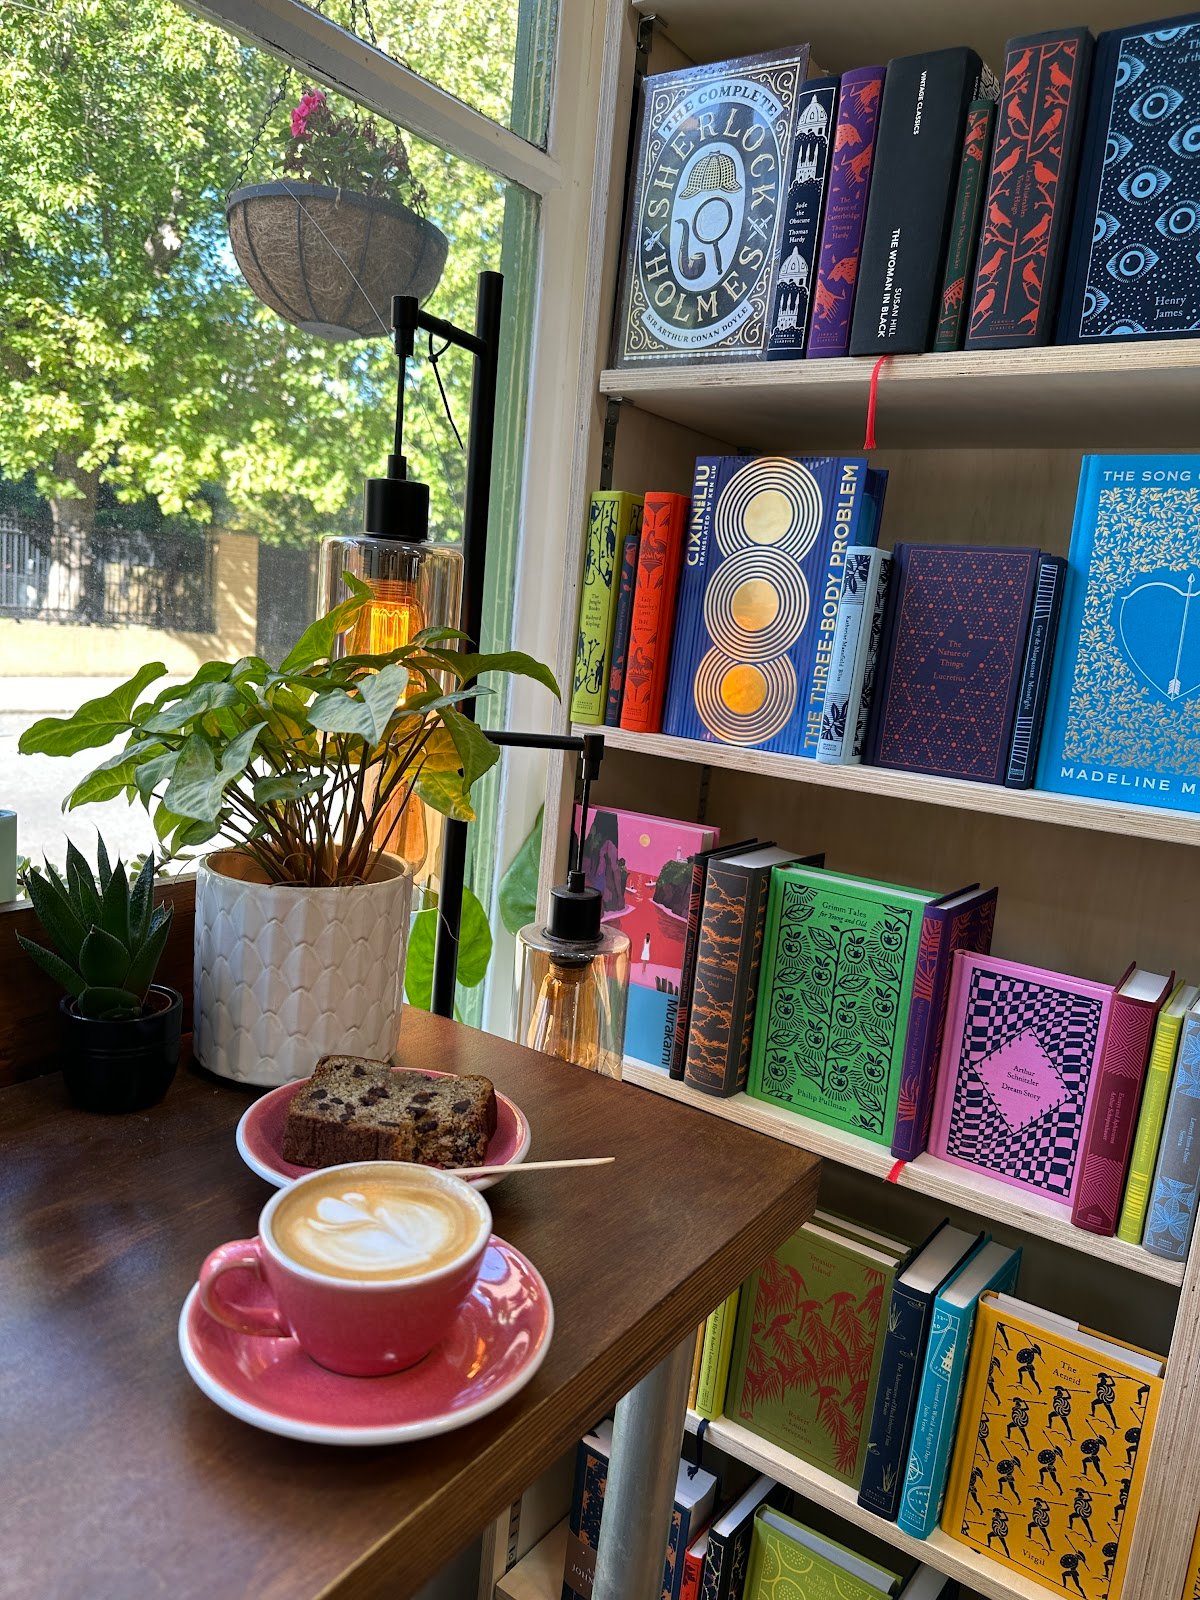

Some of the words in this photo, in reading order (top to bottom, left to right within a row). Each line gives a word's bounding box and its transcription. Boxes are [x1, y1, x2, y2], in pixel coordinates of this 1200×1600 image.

[1178, 53, 1190, 64] of
[917, 70, 927, 101] VINTAGE
[663, 102, 694, 133] THE
[698, 85, 778, 117] COMPLETE
[913, 101, 923, 135] CLASSICS
[648, 107, 775, 218] SHERLOCK
[795, 202, 808, 210] Jude
[890, 228, 900, 248] THE
[884, 250, 897, 291] WOMAN
[645, 246, 763, 322] HOLMES
[882, 293, 891, 304] IN
[891, 287, 902, 317] SUSAN
[1155, 296, 1186, 307] Henry
[646, 315, 657, 328] SIR
[657, 325, 689, 342] ARTHUR
[690, 329, 720, 342] CONAN
[722, 306, 748, 332] DOYLE
[877, 306, 889, 338] BLACK
[1154, 309, 1183, 320] James
[888, 319, 898, 338] HILL
[693, 465, 710, 500] LIU
[1103, 471, 1135, 482] THE
[1141, 470, 1191, 482] SONG
[829, 465, 859, 567] PROBLEM
[687, 507, 705, 566] CIXIN
[699, 515, 710, 567] TRANSLATED
[706, 501, 712, 512] BY
[810, 573, 842, 705] THREE-BODY
[1035, 624, 1044, 639] Guy
[803, 711, 823, 749] THE
[1060, 766, 1171, 791] MADELINE
[822, 901, 846, 913] Grimm
[848, 907, 867, 918] Tales
[661, 998, 678, 1066] Murakami
[1006, 1071, 1039, 1087] Schnitzler
[1013, 1065, 1036, 1076] Arthur
[797, 1088, 817, 1103] Philip
[818, 1096, 847, 1111] Pullman
[1001, 1082, 1023, 1095] Dream
[1023, 1090, 1041, 1102] Story
[1052, 1368, 1081, 1385] Aeneid
[1060, 1360, 1077, 1373] The
[1022, 1548, 1045, 1566] Virgil
